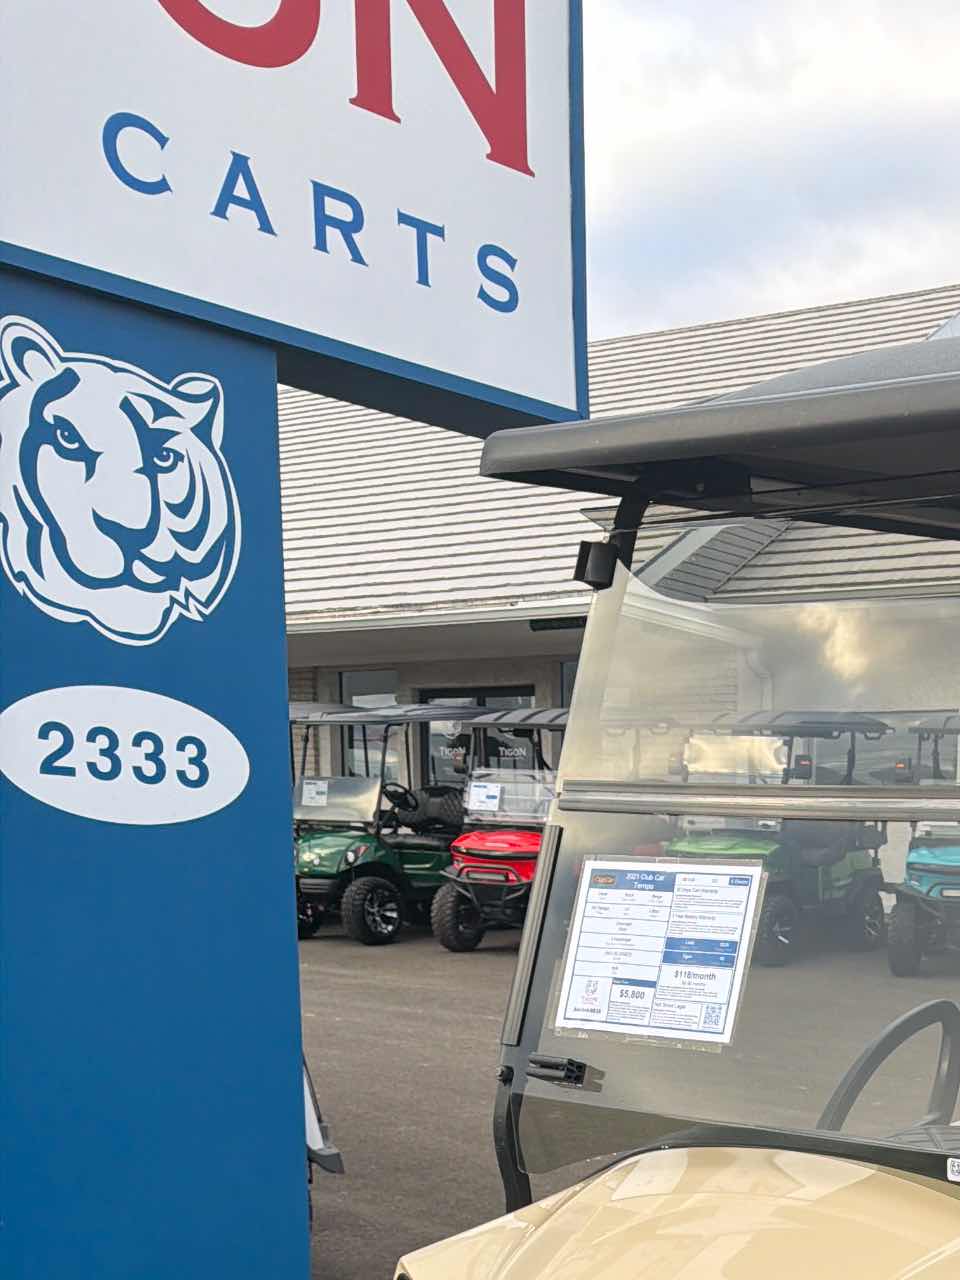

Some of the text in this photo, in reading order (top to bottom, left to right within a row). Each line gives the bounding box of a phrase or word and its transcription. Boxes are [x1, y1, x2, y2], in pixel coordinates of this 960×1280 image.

[102, 111, 520, 313] CARTS
[37, 720, 210, 789] 2333
[498, 746, 528, 757] TIGON
[625, 872, 640, 881] 2021
[640, 873, 654, 881] Club
[654, 874, 665, 882] Car
[633, 881, 655, 890] Tempo
[619, 988, 646, 1000] $5,800
